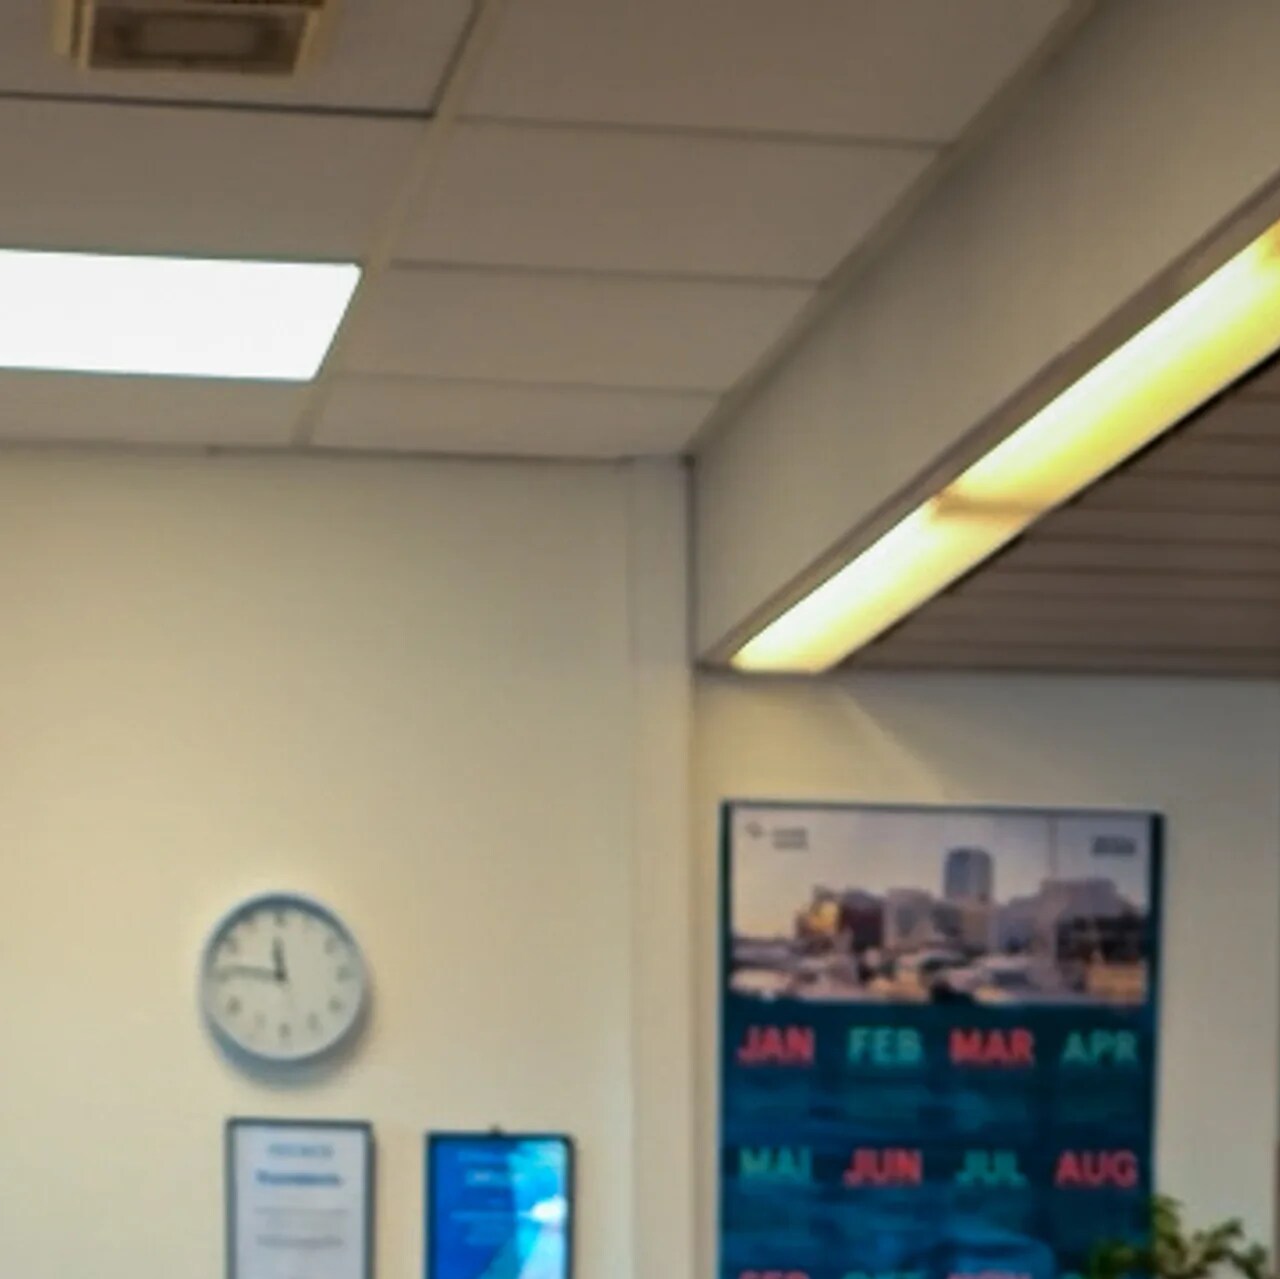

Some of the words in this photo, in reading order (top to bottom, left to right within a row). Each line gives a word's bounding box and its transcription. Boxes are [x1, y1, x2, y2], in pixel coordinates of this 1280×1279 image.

[739, 1027, 812, 1063] JAN
[849, 1028, 921, 1063] FEB
[950, 1029, 1033, 1064] MAR
[1062, 1031, 1135, 1063] APR
[740, 1149, 810, 1183] MAI
[844, 1149, 921, 1185] JUN
[957, 1152, 1022, 1184] JUL
[1055, 1151, 1137, 1186] AUG
